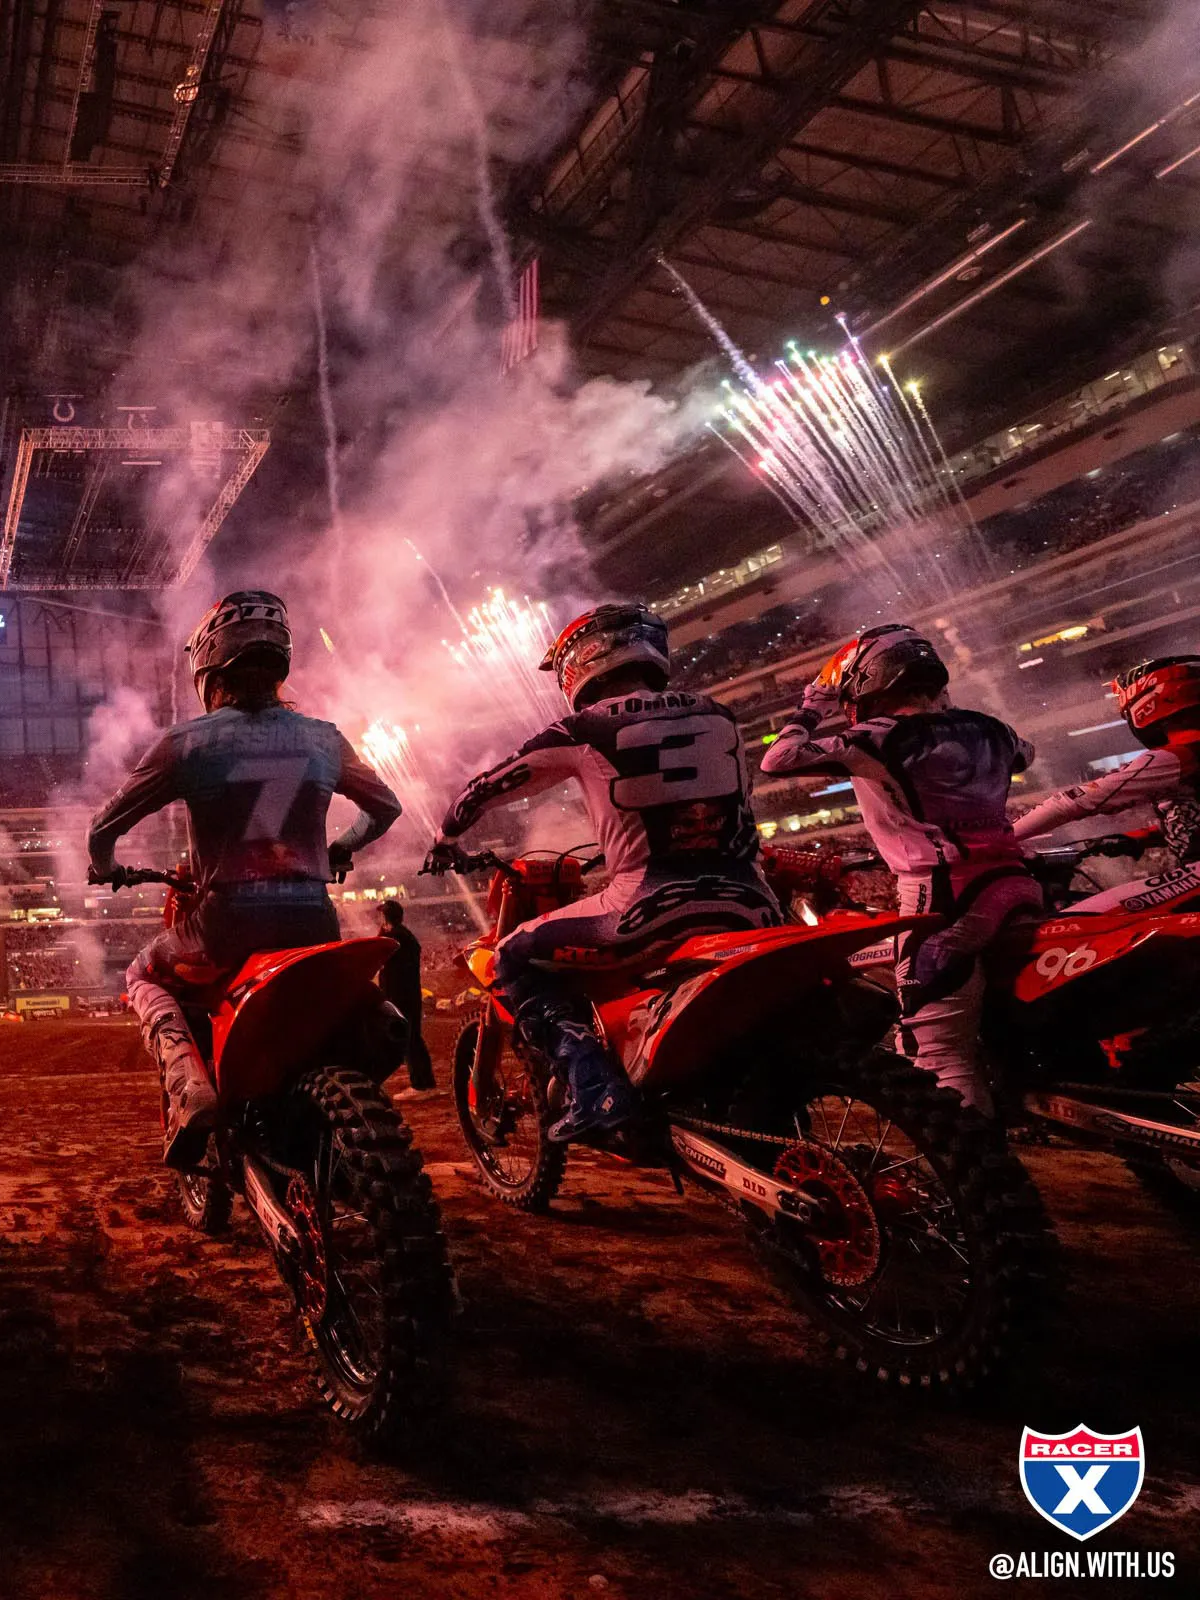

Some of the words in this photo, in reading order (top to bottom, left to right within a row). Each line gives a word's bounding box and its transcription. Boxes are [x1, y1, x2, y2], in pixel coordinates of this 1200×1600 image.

[606, 693, 697, 717] TOMAC
[1118, 672, 1158, 708] 00%
[614, 714, 742, 808] 3
[226, 757, 309, 840] 7
[1139, 876, 1200, 905] YAMAHA
[1039, 922, 1082, 935] NDA
[1036, 942, 1098, 984] 96
